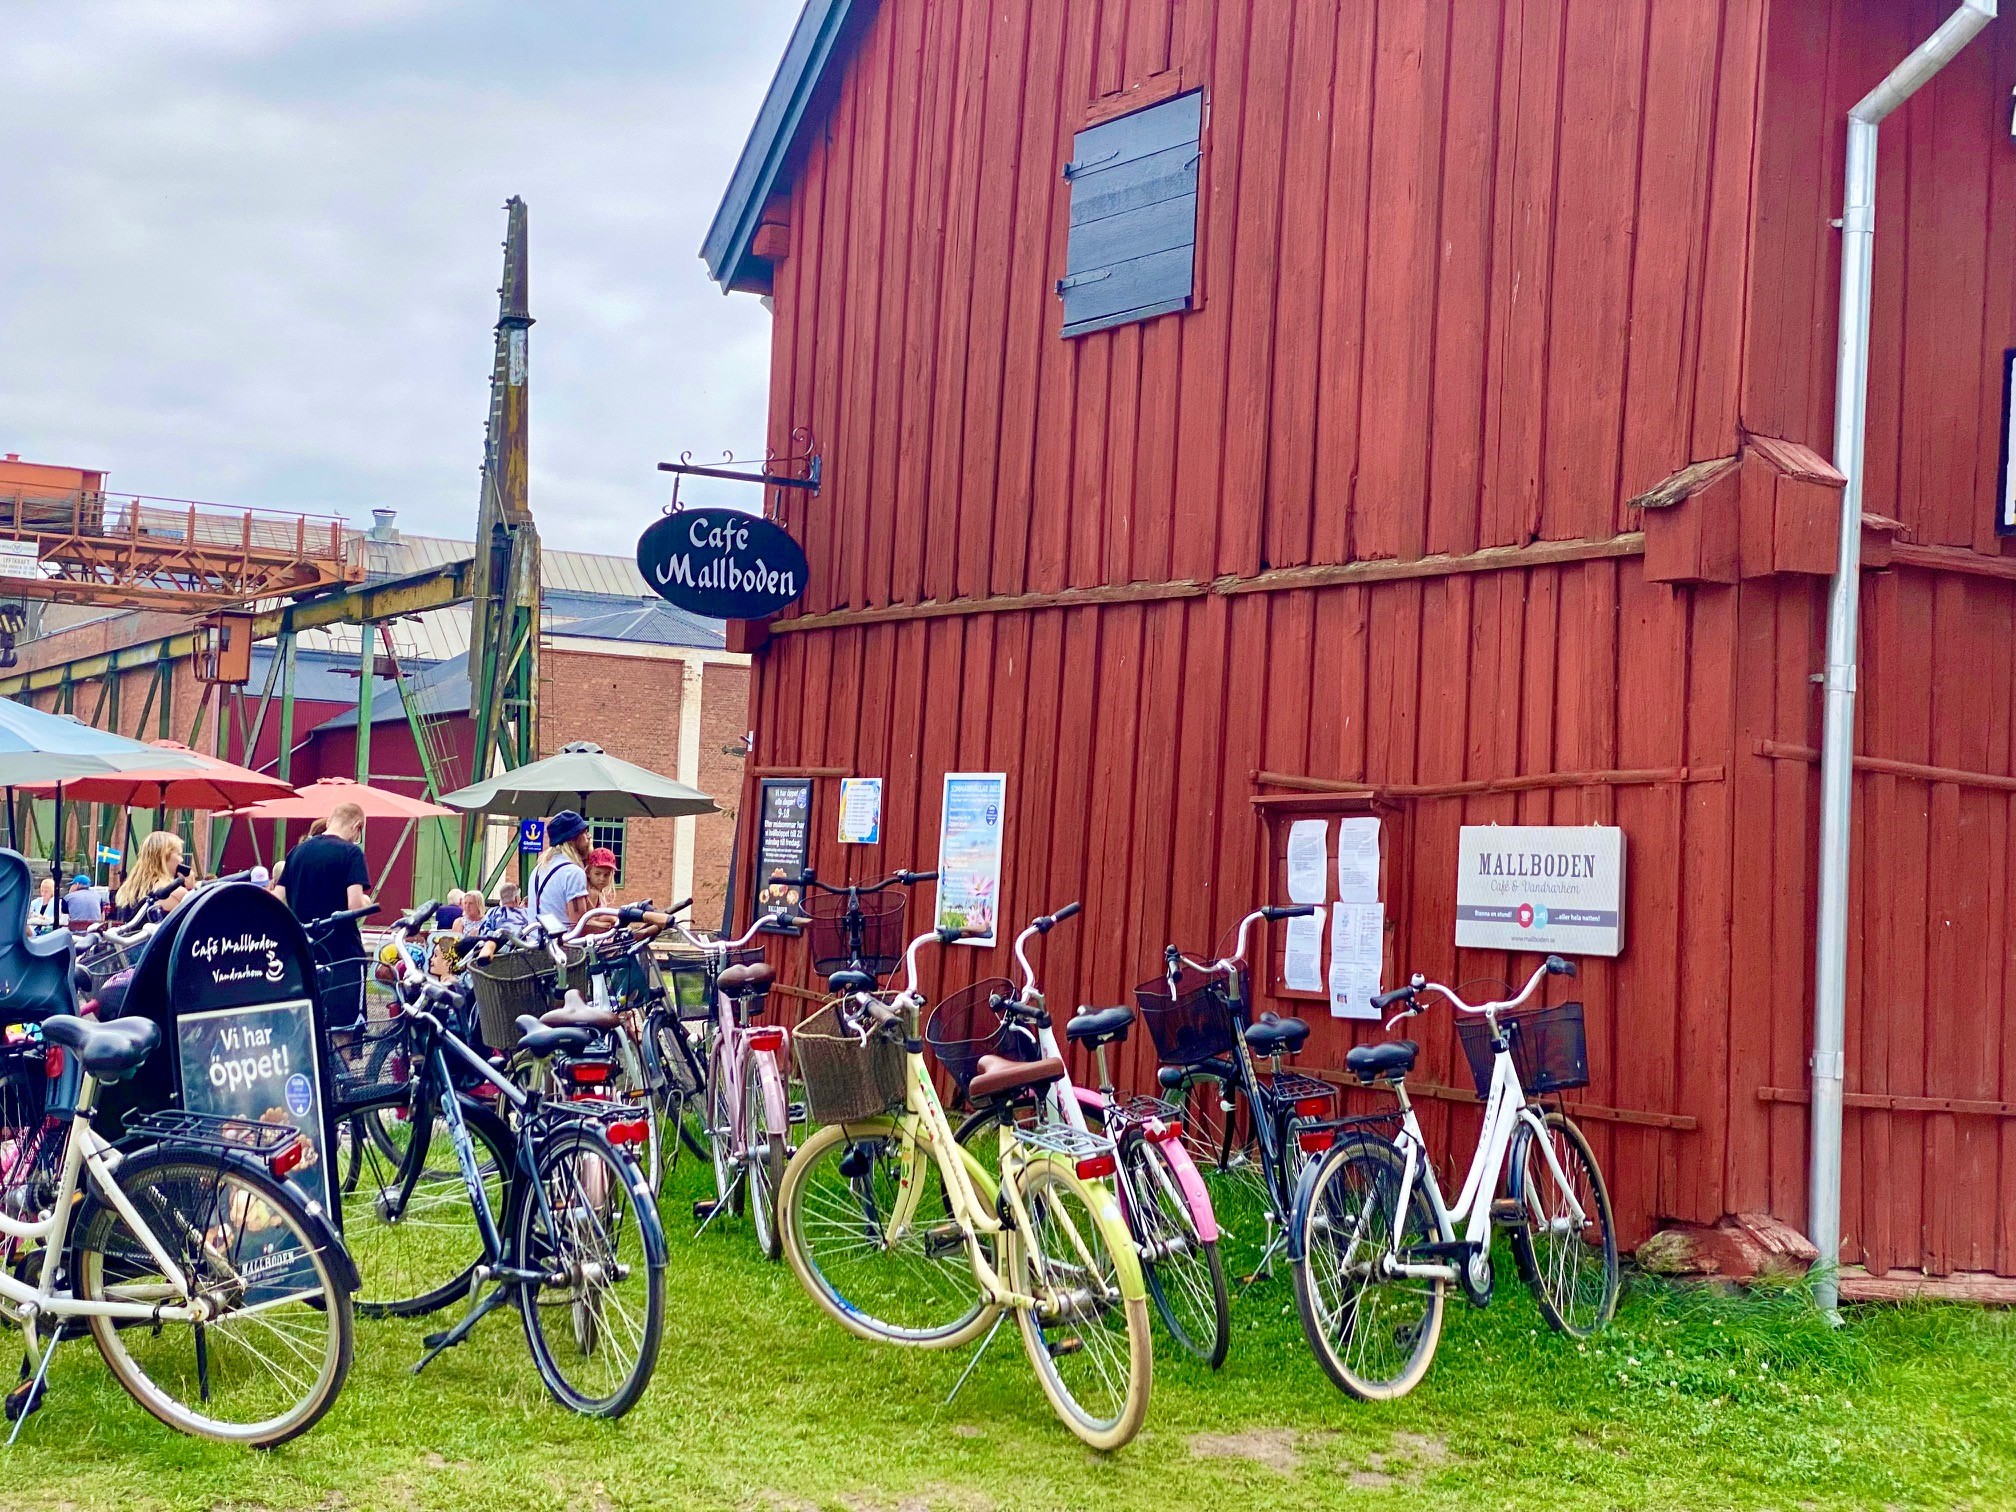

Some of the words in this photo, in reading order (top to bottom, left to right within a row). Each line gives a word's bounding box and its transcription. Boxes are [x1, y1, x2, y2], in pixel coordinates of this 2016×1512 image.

[688, 516, 750, 554] Café
[656, 553, 797, 596] Mallboden
[1478, 852, 1596, 878] MALLBODEN
[1490, 879, 1509, 895] Café
[1511, 880, 1519, 892] &
[1522, 880, 1580, 895] Vandrarhem
[1474, 909, 1490, 917] Stanna
[1582, 914, 1600, 922] natten!
[191, 936, 218, 962] Café
[221, 934, 279, 956] Mallboden
[1510, 935, 1556, 944] www.mallboden.se
[212, 964, 263, 984] Vandrarhem
[220, 1027, 239, 1051] Vi
[242, 1026, 273, 1048] har
[208, 1044, 290, 1092] öppet!
